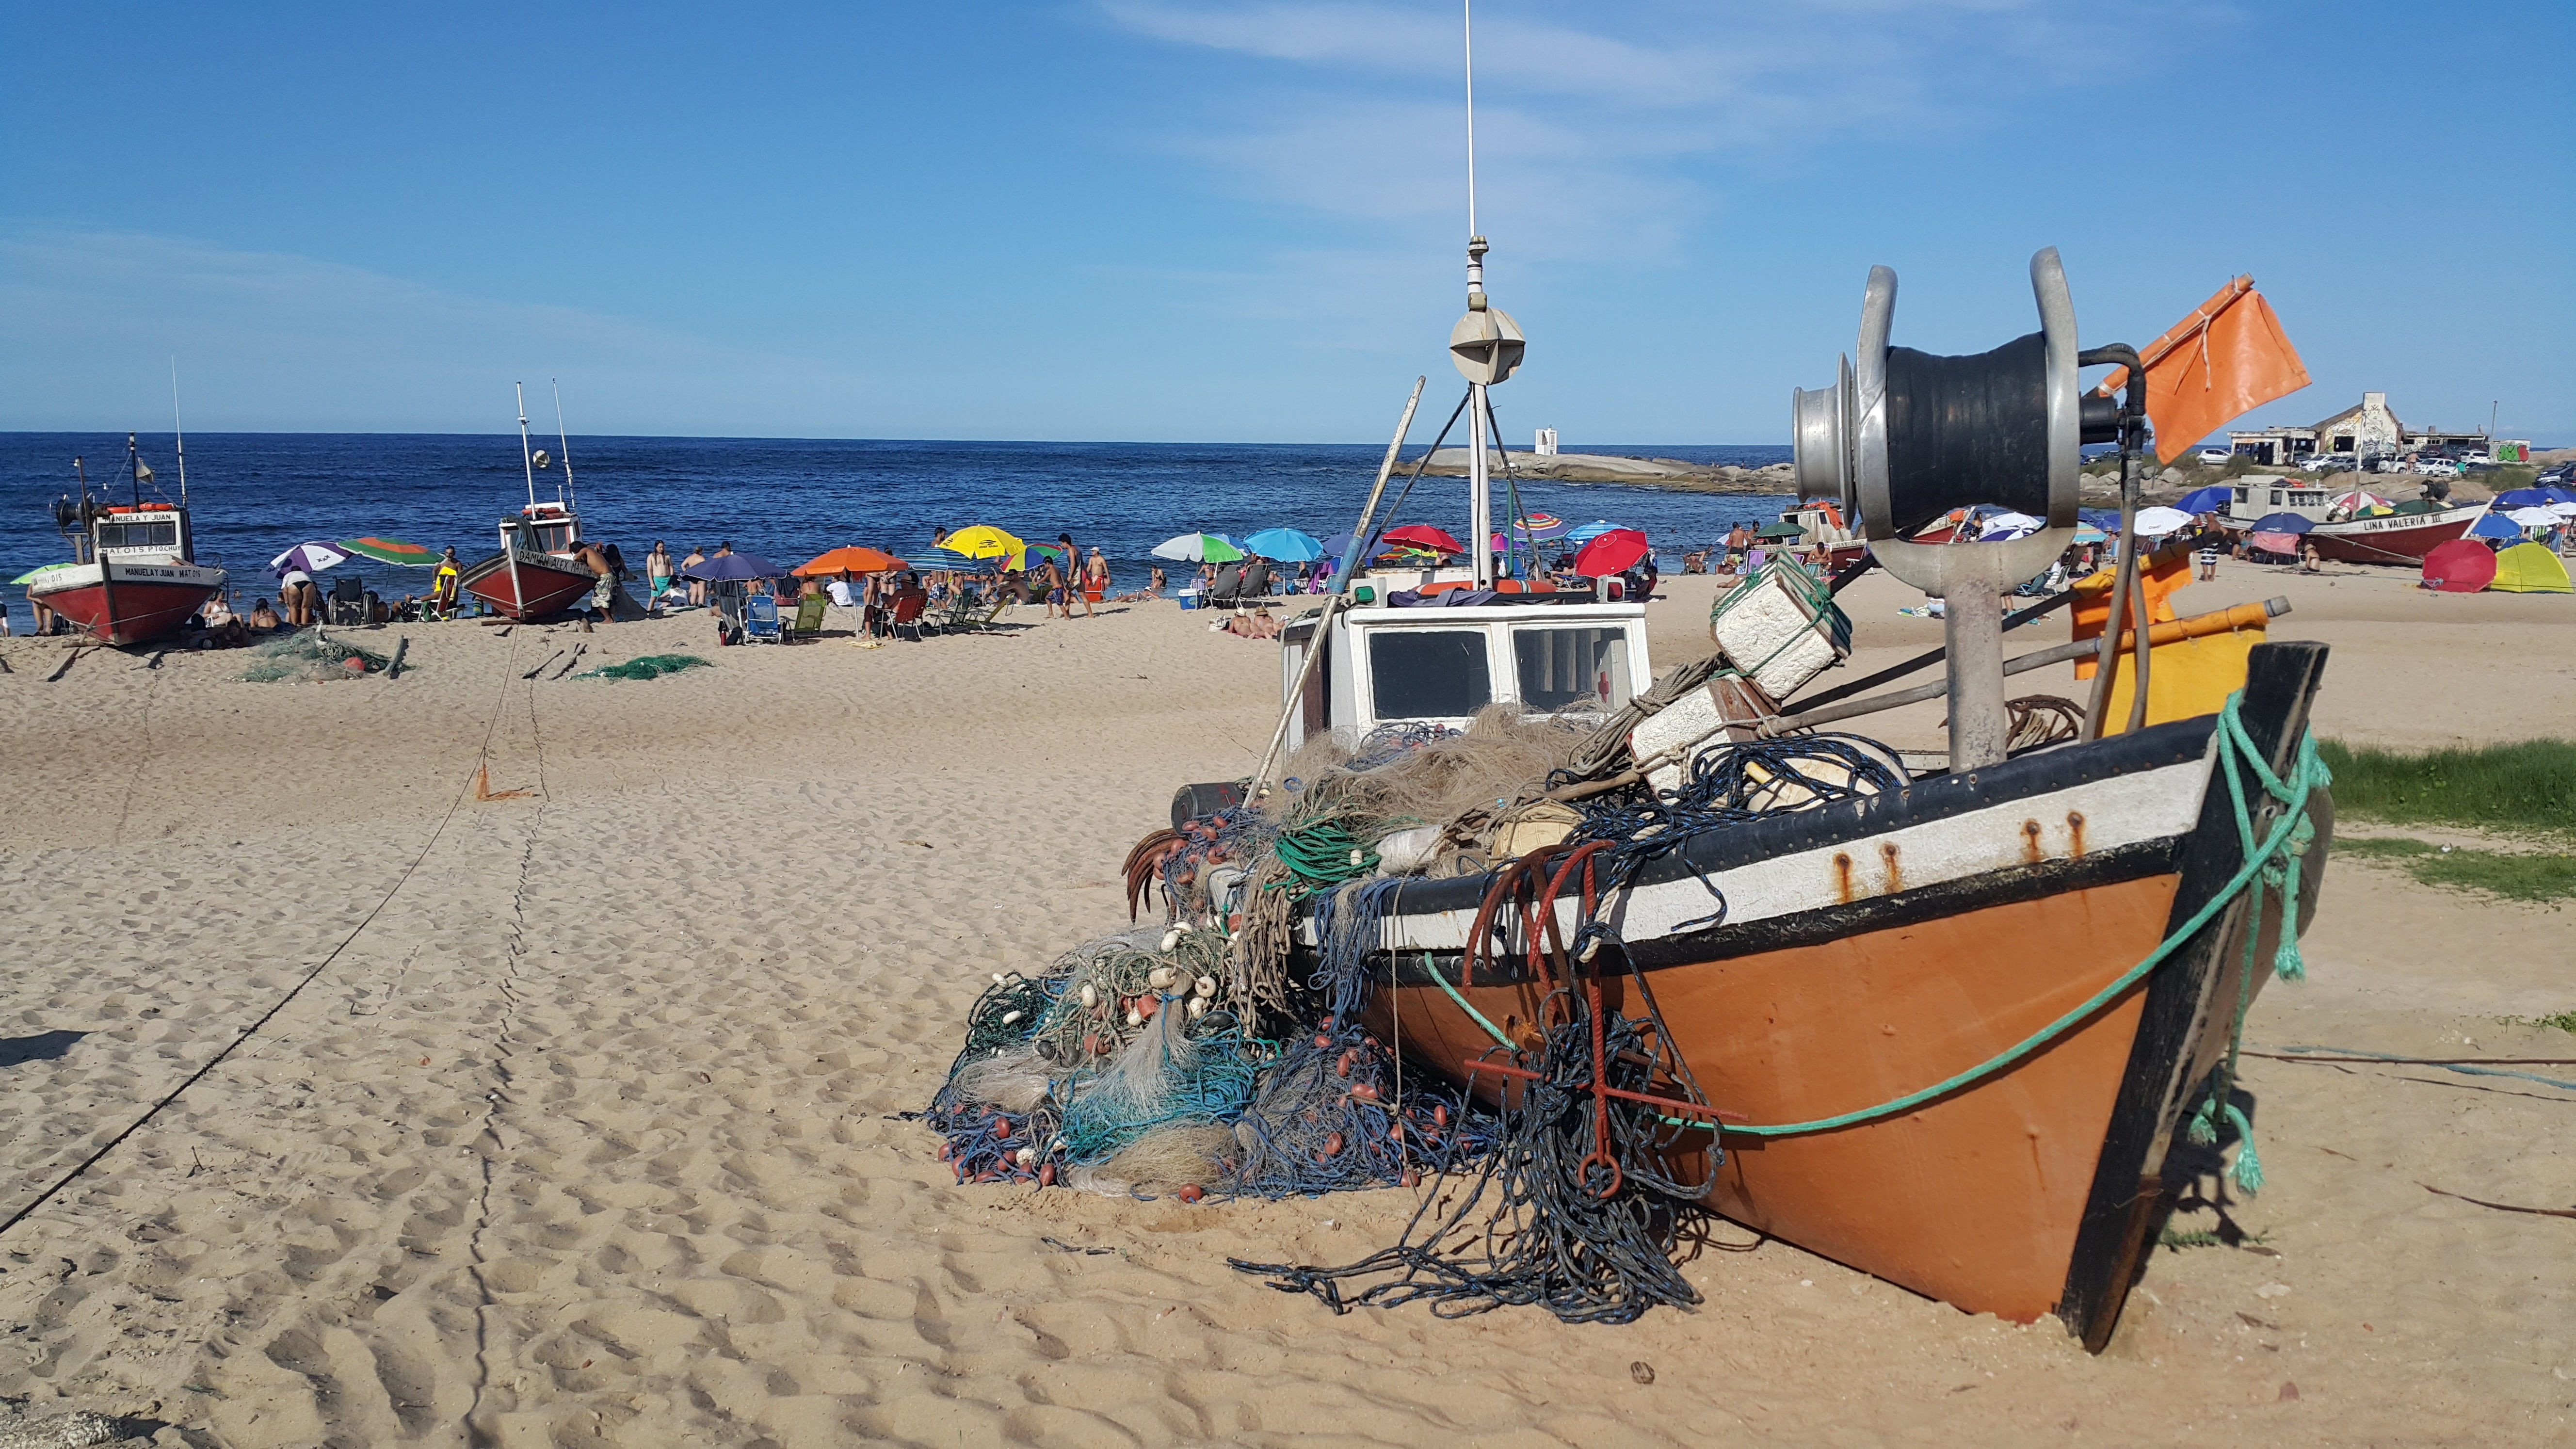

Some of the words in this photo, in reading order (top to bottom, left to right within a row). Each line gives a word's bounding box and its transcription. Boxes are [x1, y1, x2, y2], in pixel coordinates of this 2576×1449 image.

[2364, 521, 2383, 531] LINA
[550, 558, 569, 571] ALEX
[160, 569, 174, 578] JUAN
